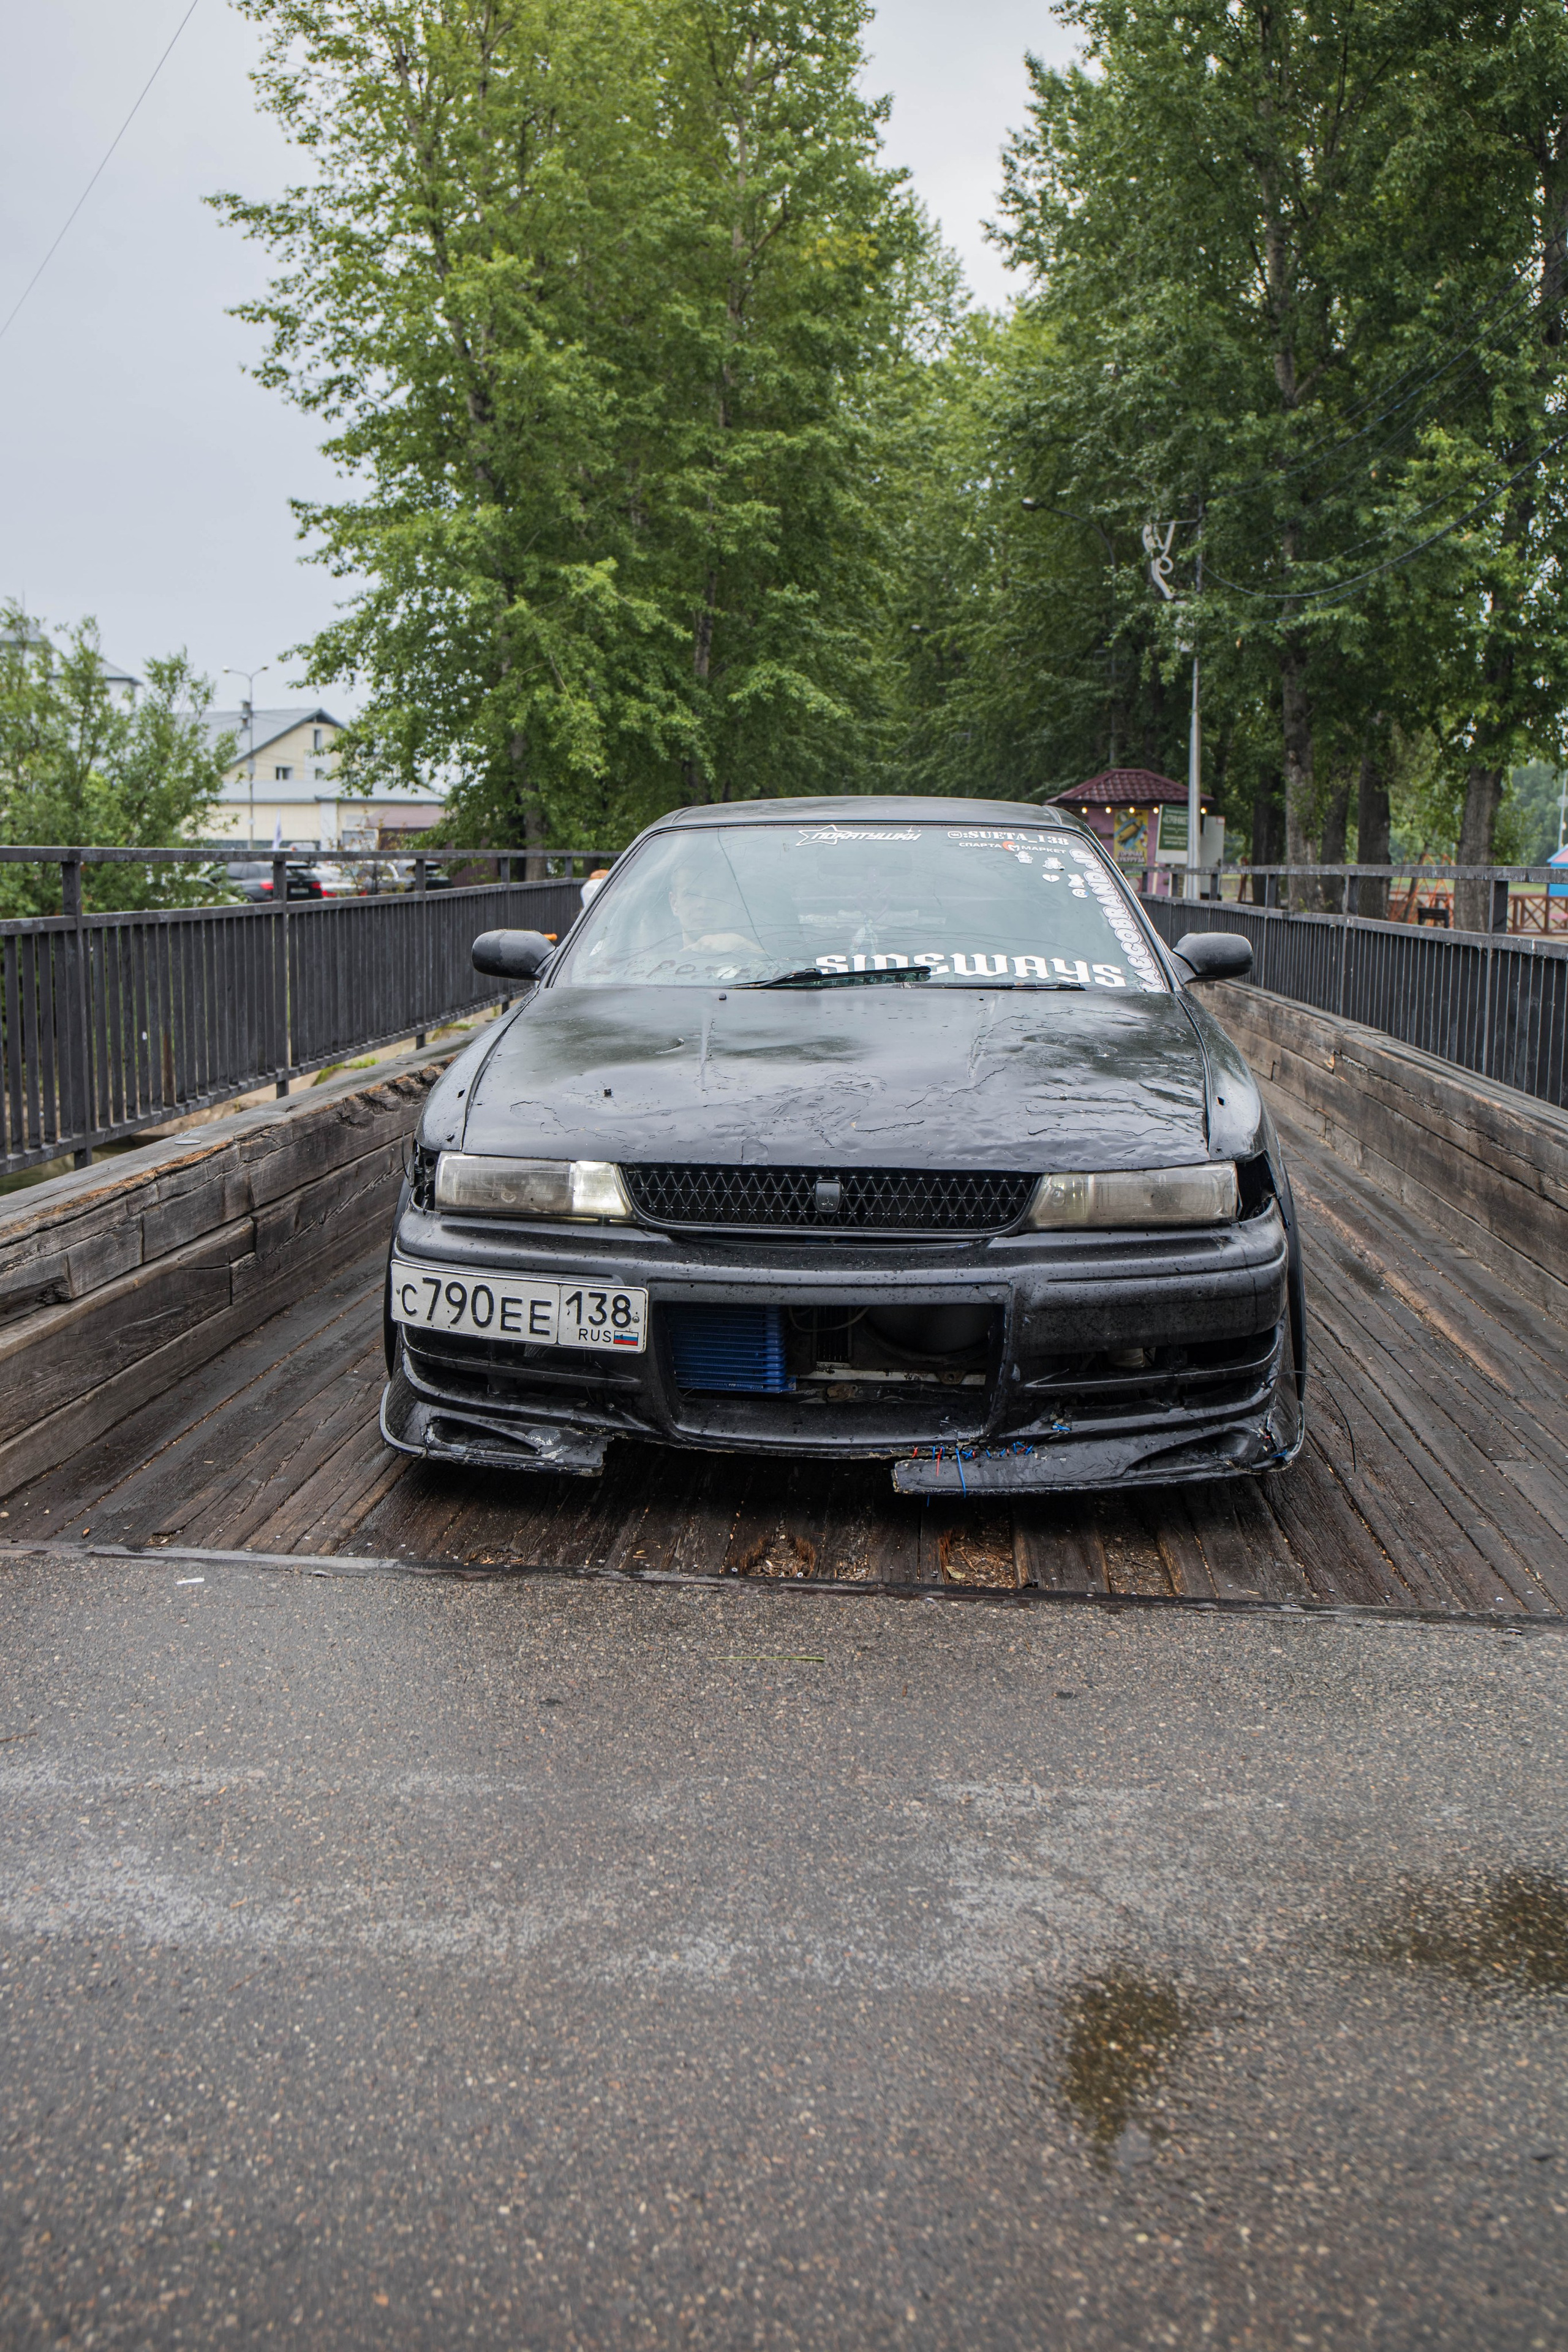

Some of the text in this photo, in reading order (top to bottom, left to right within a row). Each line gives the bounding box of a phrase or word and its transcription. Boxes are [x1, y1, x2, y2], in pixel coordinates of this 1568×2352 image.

[811, 831, 921, 841] ПОКАТУШКИ
[1021, 845, 1067, 854] МАРКЕТ
[565, 1291, 632, 1328] 138
[578, 1328, 612, 1343] RUS
